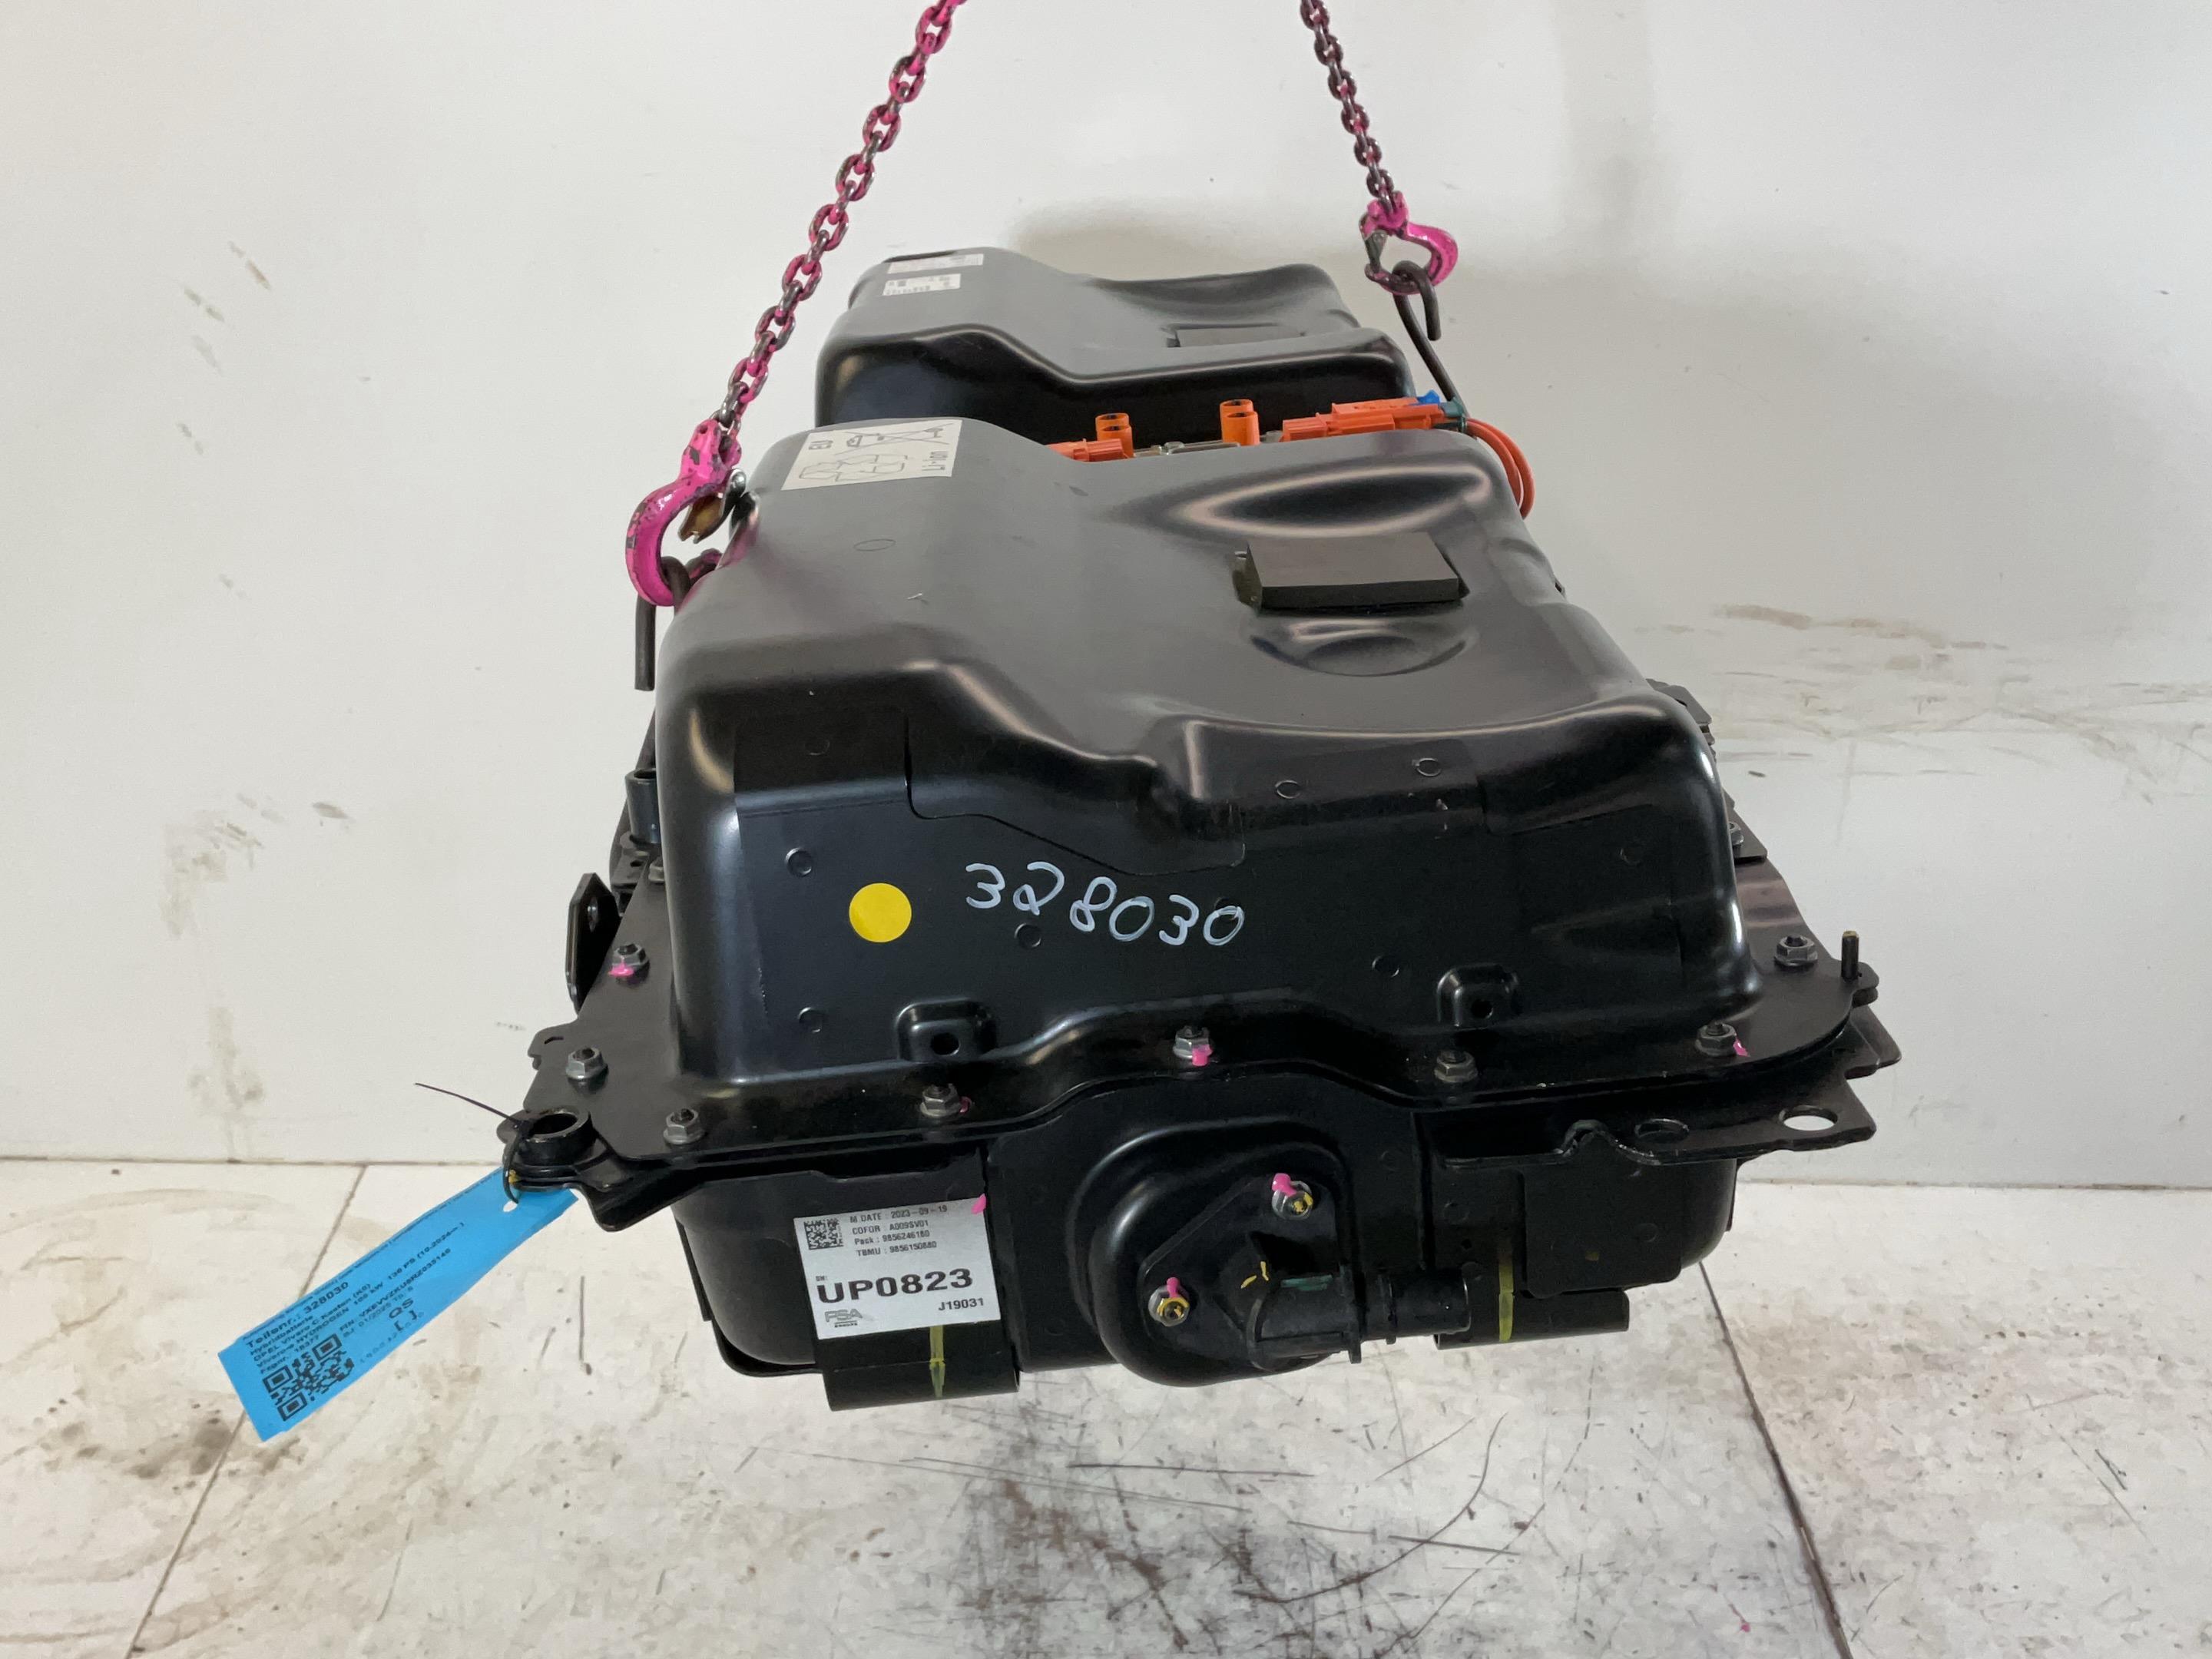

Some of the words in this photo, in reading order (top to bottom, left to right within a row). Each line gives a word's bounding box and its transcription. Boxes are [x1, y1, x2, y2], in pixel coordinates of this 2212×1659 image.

[965, 861, 1245, 946] 328030
[861, 1213, 882, 1222] DATE
[853, 1225, 880, 1235] COFOR
[856, 1247, 882, 1257] TBMU
[817, 1268, 973, 1303] UP0823
[303, 1282, 349, 1313] 328030
[938, 1297, 984, 1311] J19031
[389, 1297, 414, 1320] QS
